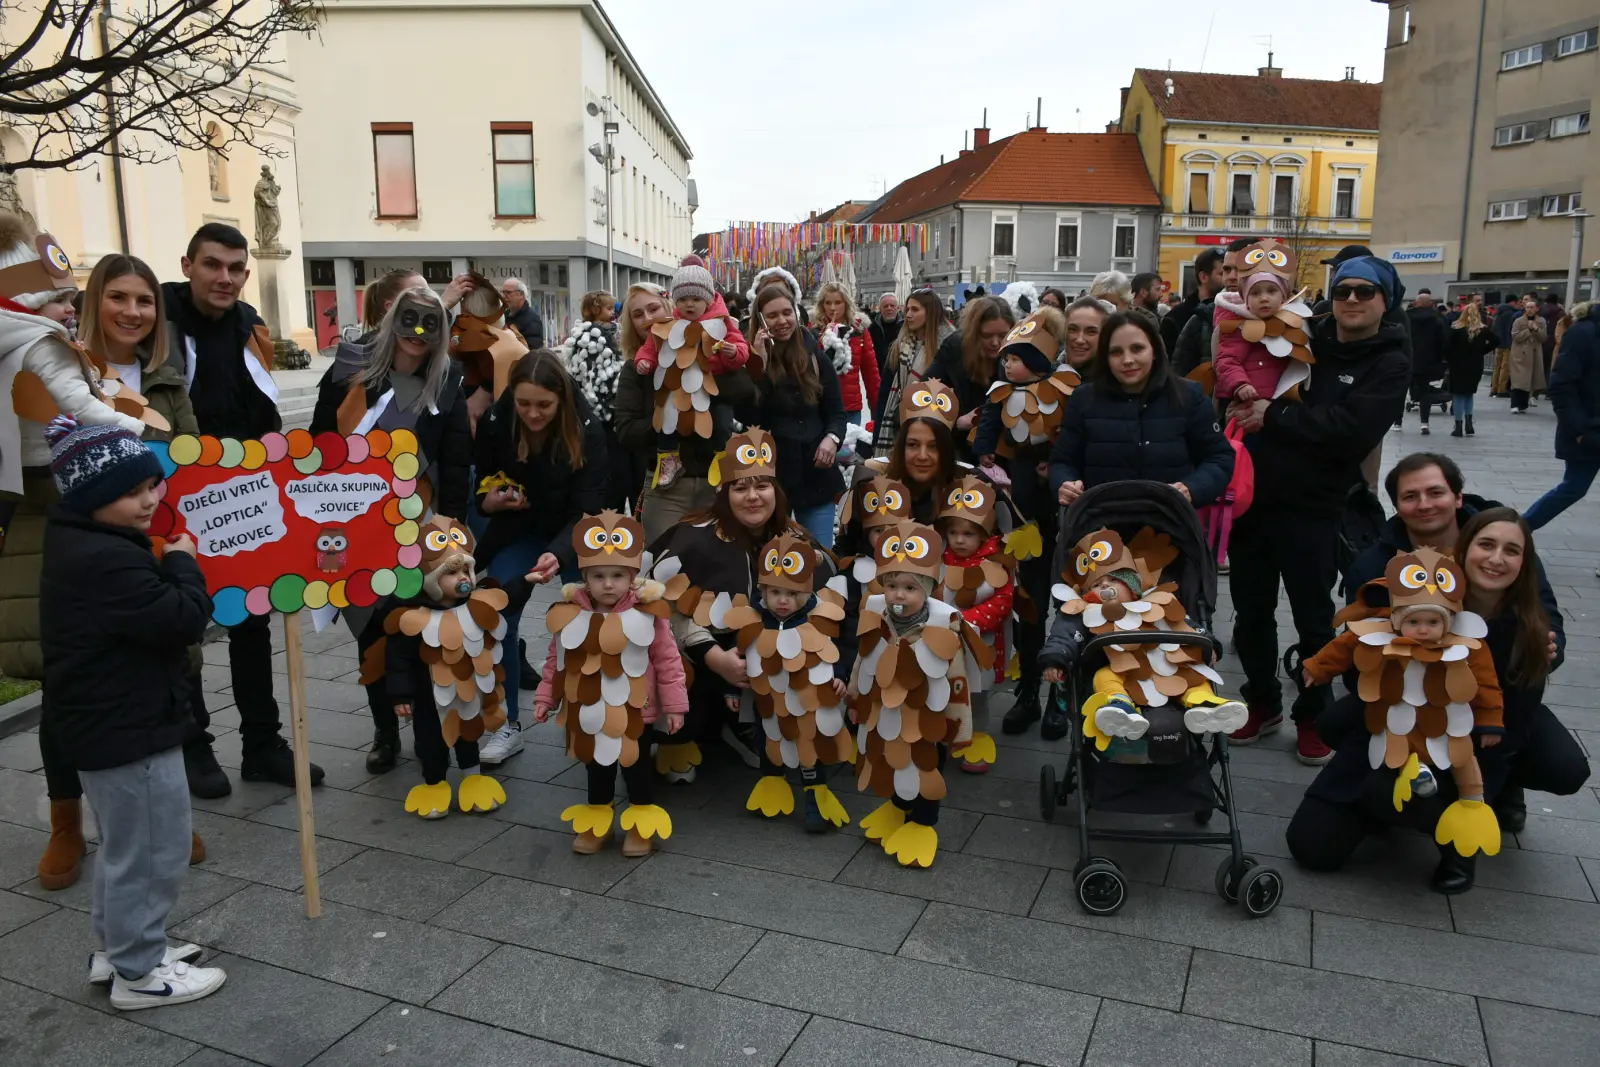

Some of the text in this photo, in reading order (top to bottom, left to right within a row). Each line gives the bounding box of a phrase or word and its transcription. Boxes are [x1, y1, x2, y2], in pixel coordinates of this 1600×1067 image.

[490, 266, 523, 278] YUKI
[183, 475, 270, 513] DJEČJI VRTIĆ
[288, 480, 388, 494] JASLIČKA SKUPINA
[314, 501, 365, 515] „SOVICE“
[200, 500, 268, 536] „LOPTICA“
[209, 524, 274, 554] ČAKOVEC
[1163, 734, 1179, 742] baby
